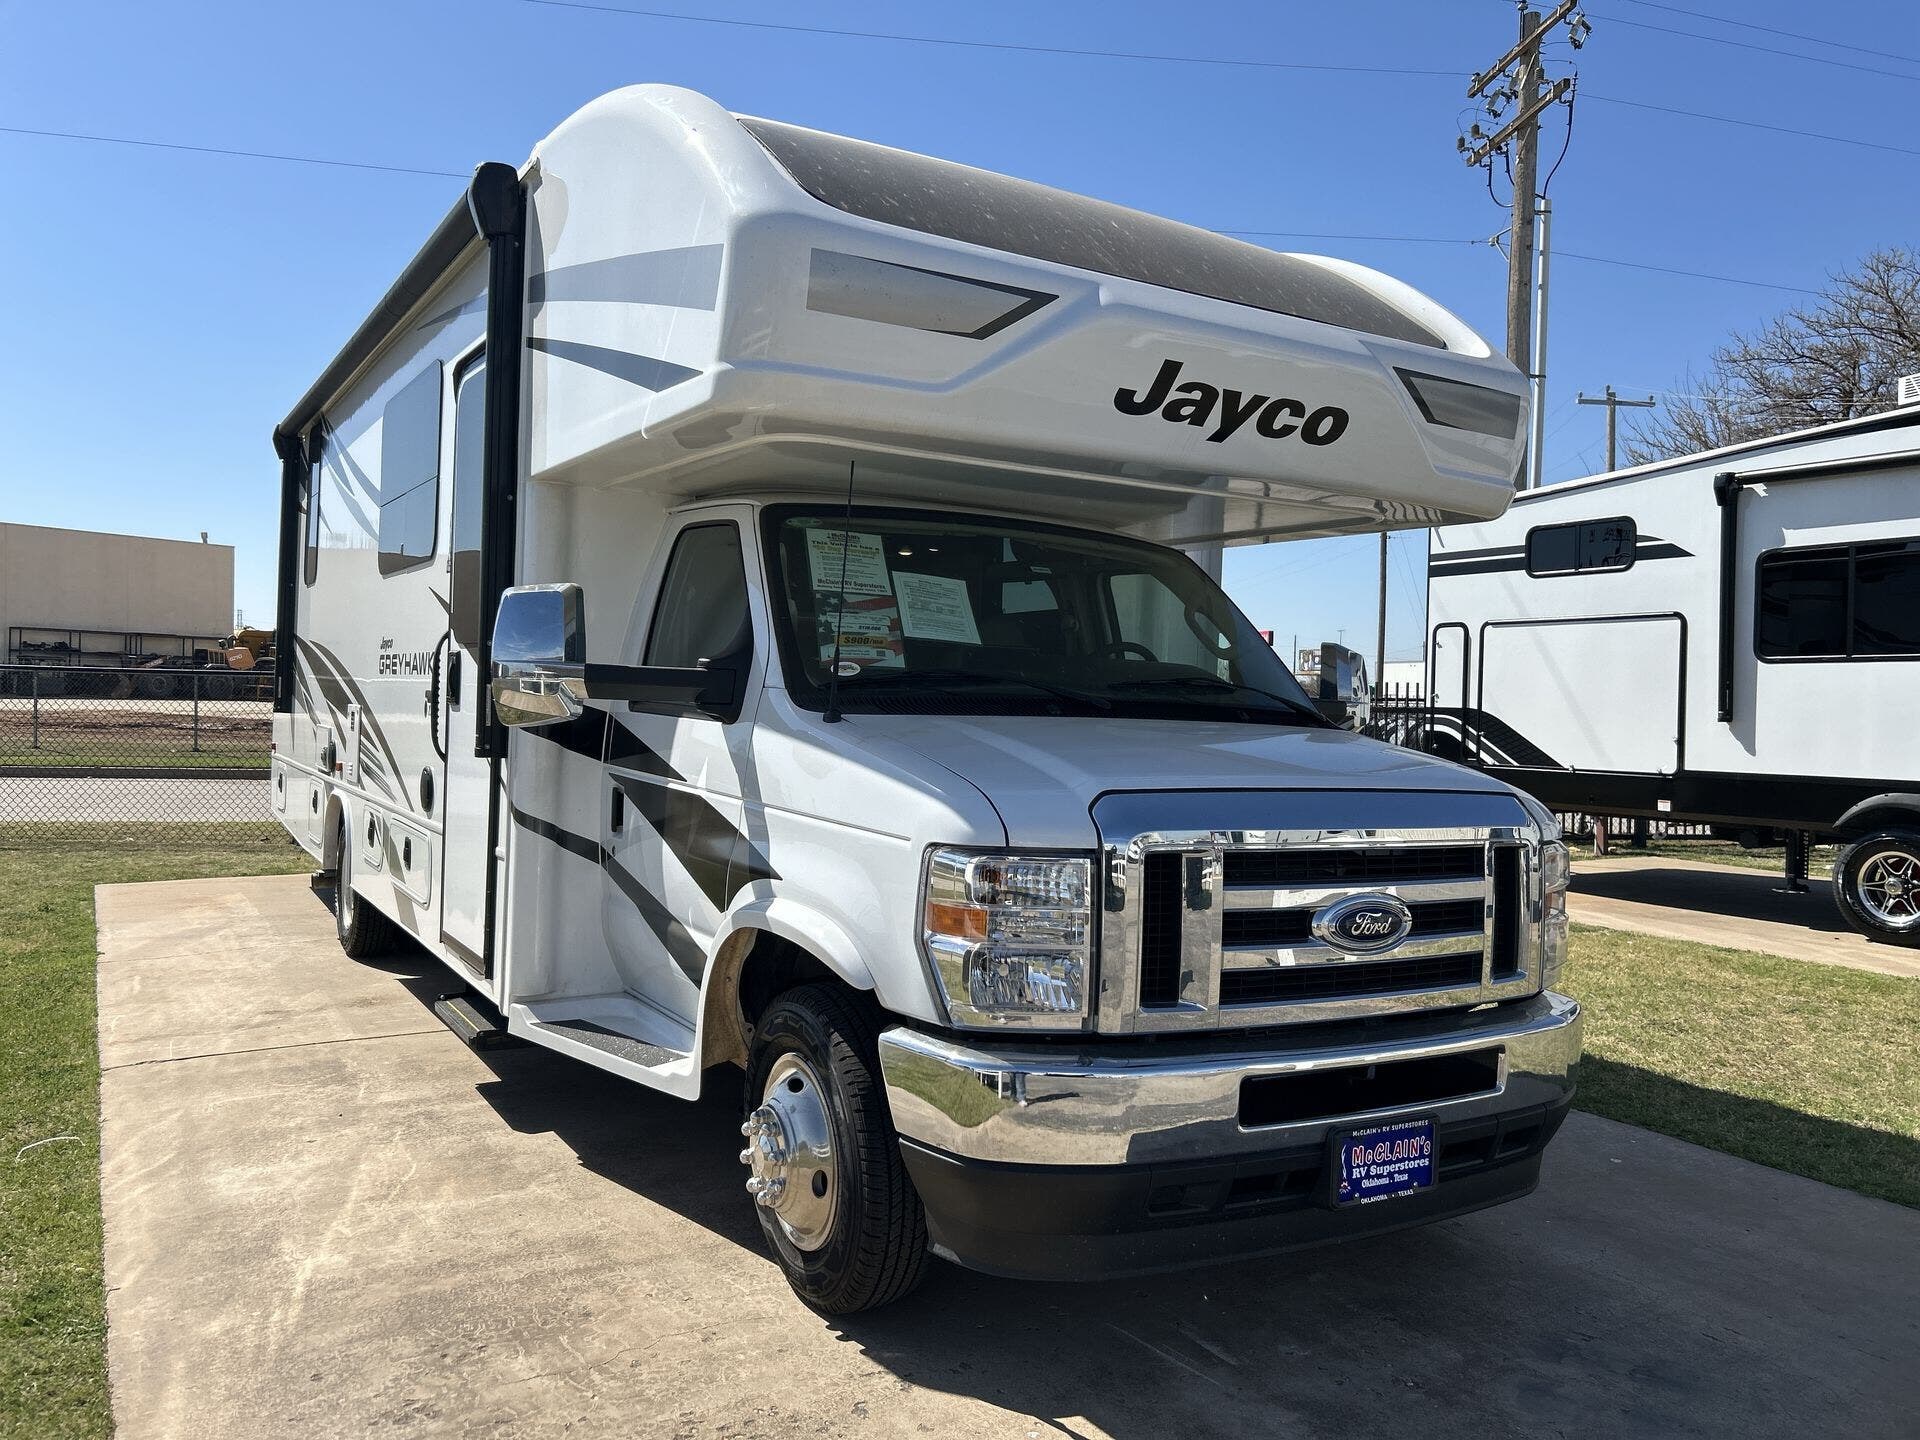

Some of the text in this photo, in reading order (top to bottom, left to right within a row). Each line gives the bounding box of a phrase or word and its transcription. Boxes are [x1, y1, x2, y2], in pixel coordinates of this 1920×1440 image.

[1113, 358, 1350, 447] Jayco
[830, 541, 858, 549] Vehcle
[379, 651, 435, 675] GREYHAWK
[1351, 911, 1393, 936] Ford
[1391, 1119, 1429, 1131] SUPERSTORES
[1352, 1158, 1429, 1179] RV Superstores
[1361, 1172, 1409, 1188] Oklahoma Texas
[1360, 1188, 1414, 1205] OKLAHOMA TEXAS
